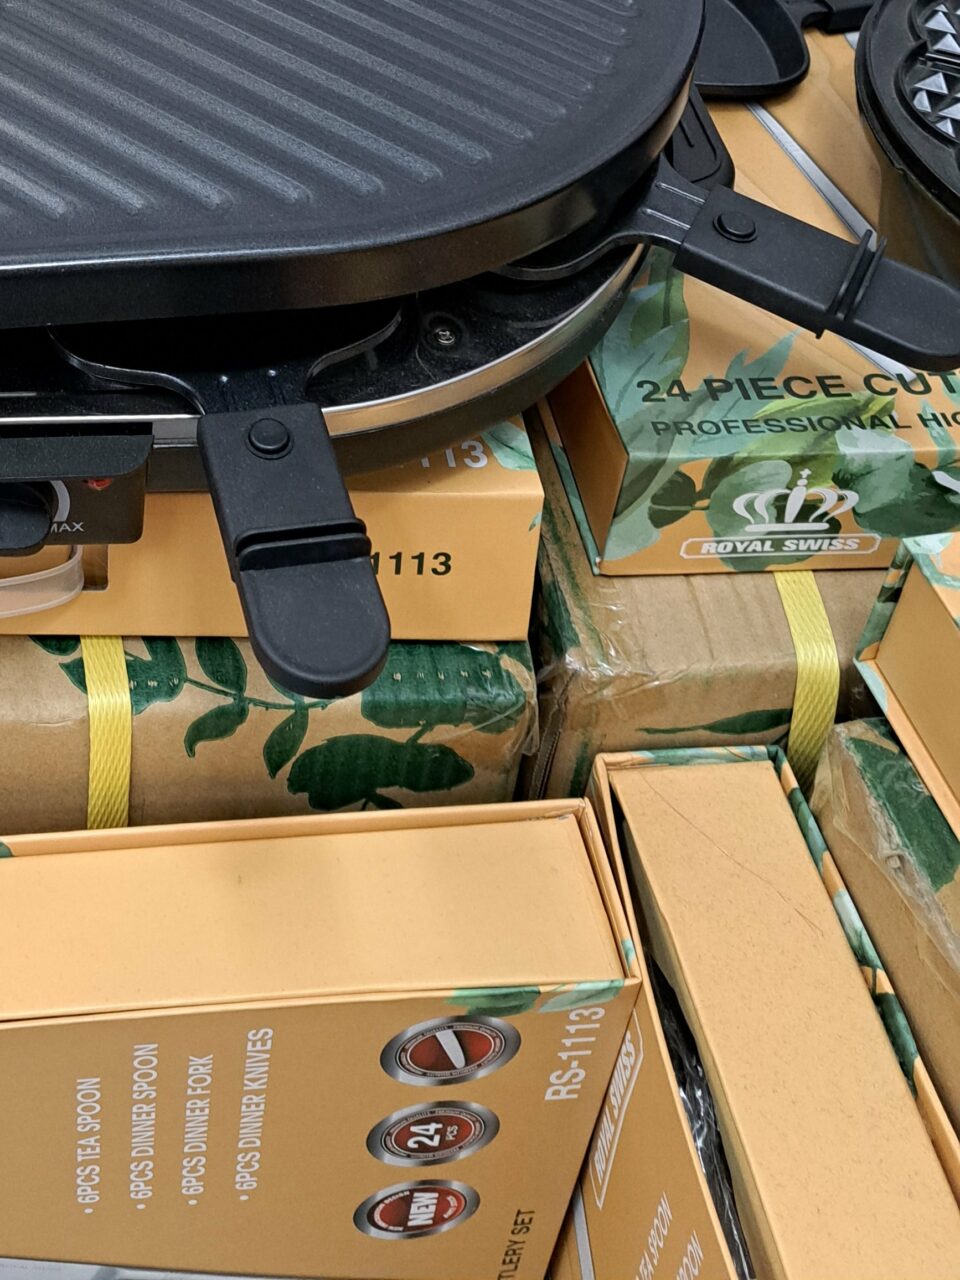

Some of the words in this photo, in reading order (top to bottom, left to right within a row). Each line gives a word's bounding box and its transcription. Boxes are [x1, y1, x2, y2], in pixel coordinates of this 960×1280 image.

[636, 379, 692, 403] 24
[703, 375, 852, 402] PIECE
[651, 413, 912, 436] PROFESSIONAL
[700, 539, 774, 554] ROYAL
[782, 538, 860, 552] SWISS
[132, 1043, 159, 1100] SPOON
[243, 1028, 273, 1091] KNIVES
[544, 1007, 605, 1100] RS-1113
[186, 1054, 213, 1096] FORK
[76, 1077, 101, 1133] SPOON
[238, 1094, 266, 1149] DINNER
[131, 1103, 156, 1157] DINNER
[183, 1098, 210, 1153] DINNER
[407, 1122, 443, 1149] 24
[445, 1125, 458, 1140] PCS
[77, 1135, 101, 1162] TEA
[76, 1164, 101, 1203] 6PCS
[130, 1160, 154, 1199] 6PCS
[181, 1156, 206, 1195] 6PCS
[235, 1151, 261, 1190] 6PCS
[407, 1192, 439, 1227] NEW
[511, 1209, 536, 1235] SET
[648, 1192, 673, 1266] SPOON
